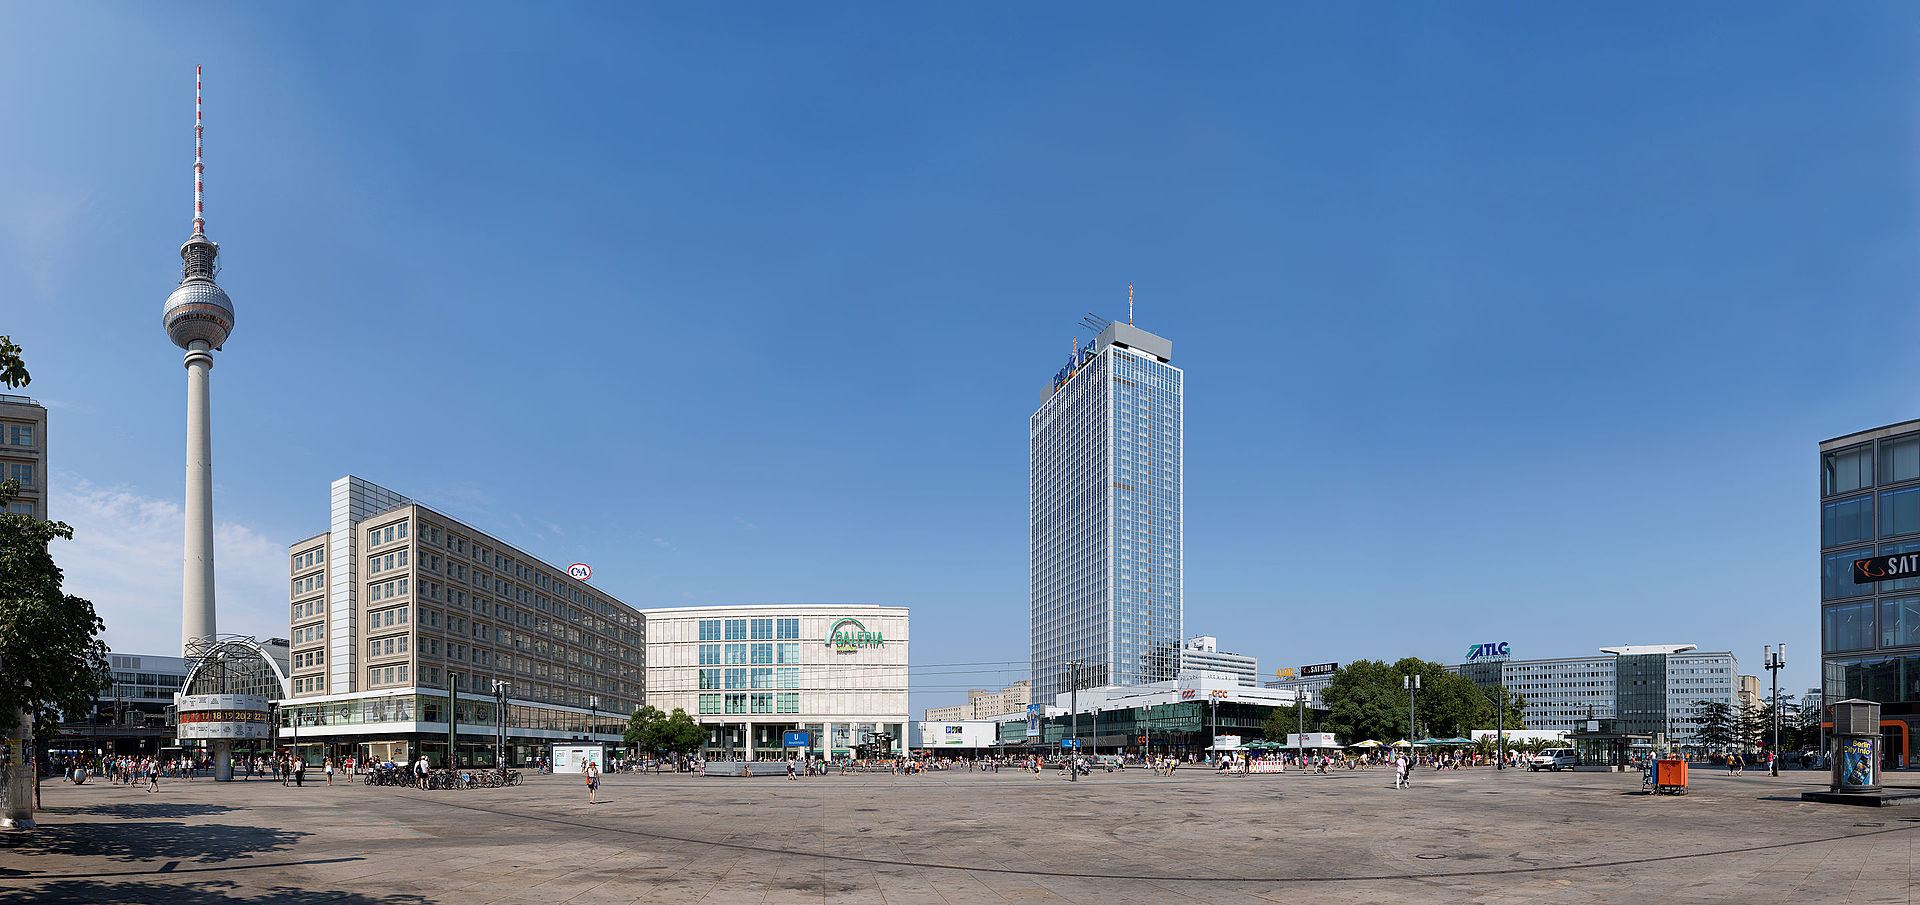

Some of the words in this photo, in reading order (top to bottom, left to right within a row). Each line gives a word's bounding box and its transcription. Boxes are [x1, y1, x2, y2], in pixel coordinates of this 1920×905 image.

[835, 631, 885, 645] GALERIA
[1276, 667, 1295, 678] ADAC
[1182, 689, 1195, 698] CCC
[1212, 689, 1228, 698] CCC
[212, 711, 221, 720] 18
[224, 712, 233, 720] 19
[235, 711, 246, 720] 20
[1853, 740, 1871, 749] Berlin
[1844, 746, 1857, 754] City
